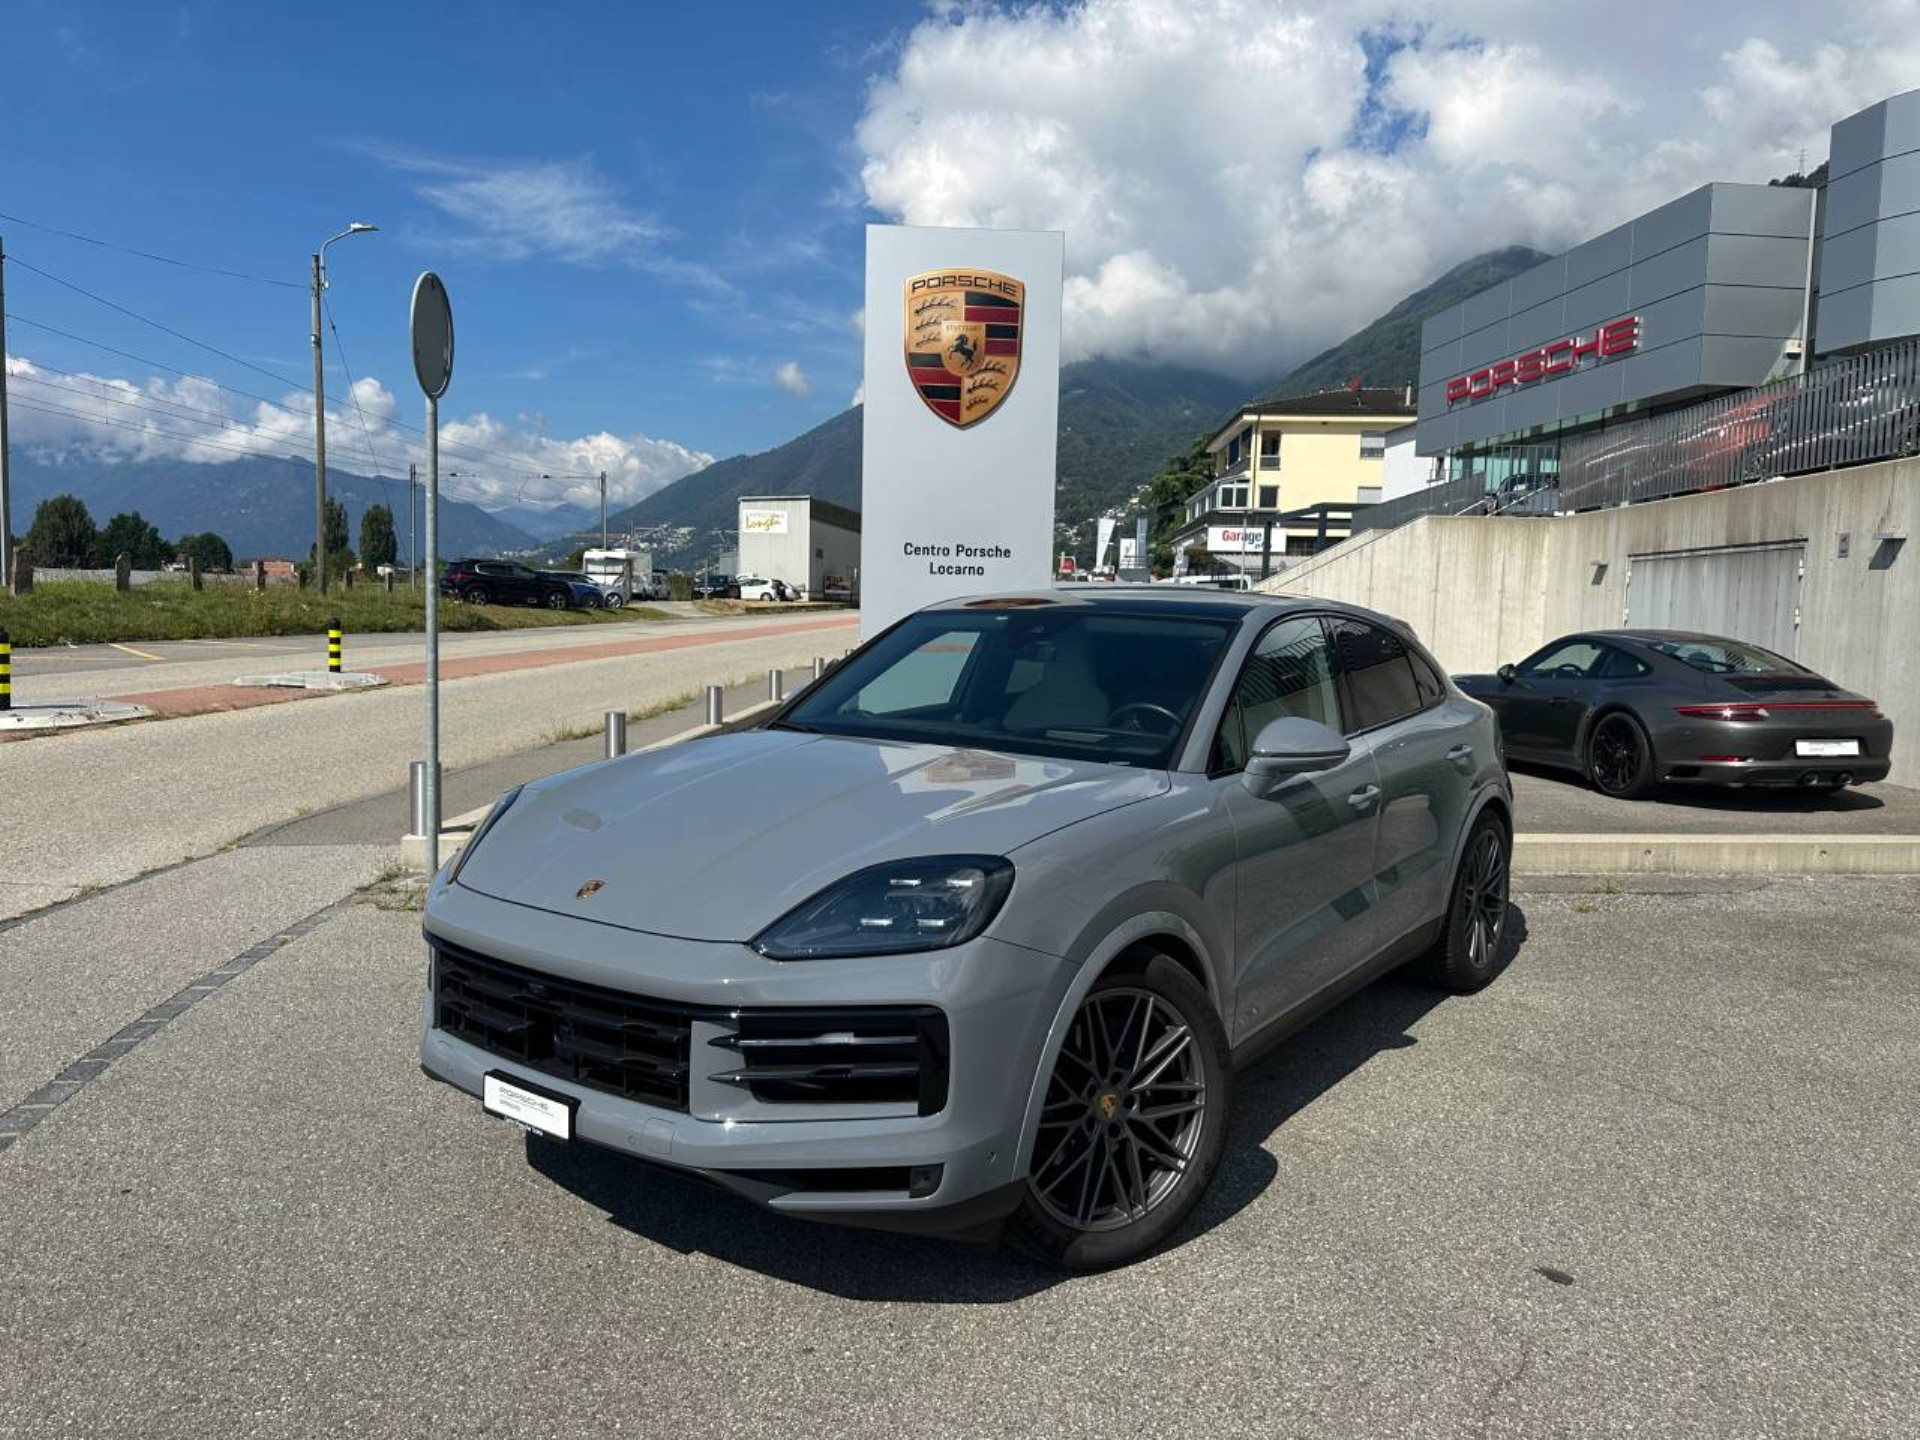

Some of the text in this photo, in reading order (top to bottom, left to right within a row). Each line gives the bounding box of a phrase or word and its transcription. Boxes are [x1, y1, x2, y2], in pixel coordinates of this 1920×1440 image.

[911, 275, 1017, 297] PORSCHE
[1446, 316, 1642, 408] PORSCHE
[1222, 530, 1262, 545] Garage
[904, 541, 1012, 559] Centro Porsche
[930, 561, 985, 576] Locarno
